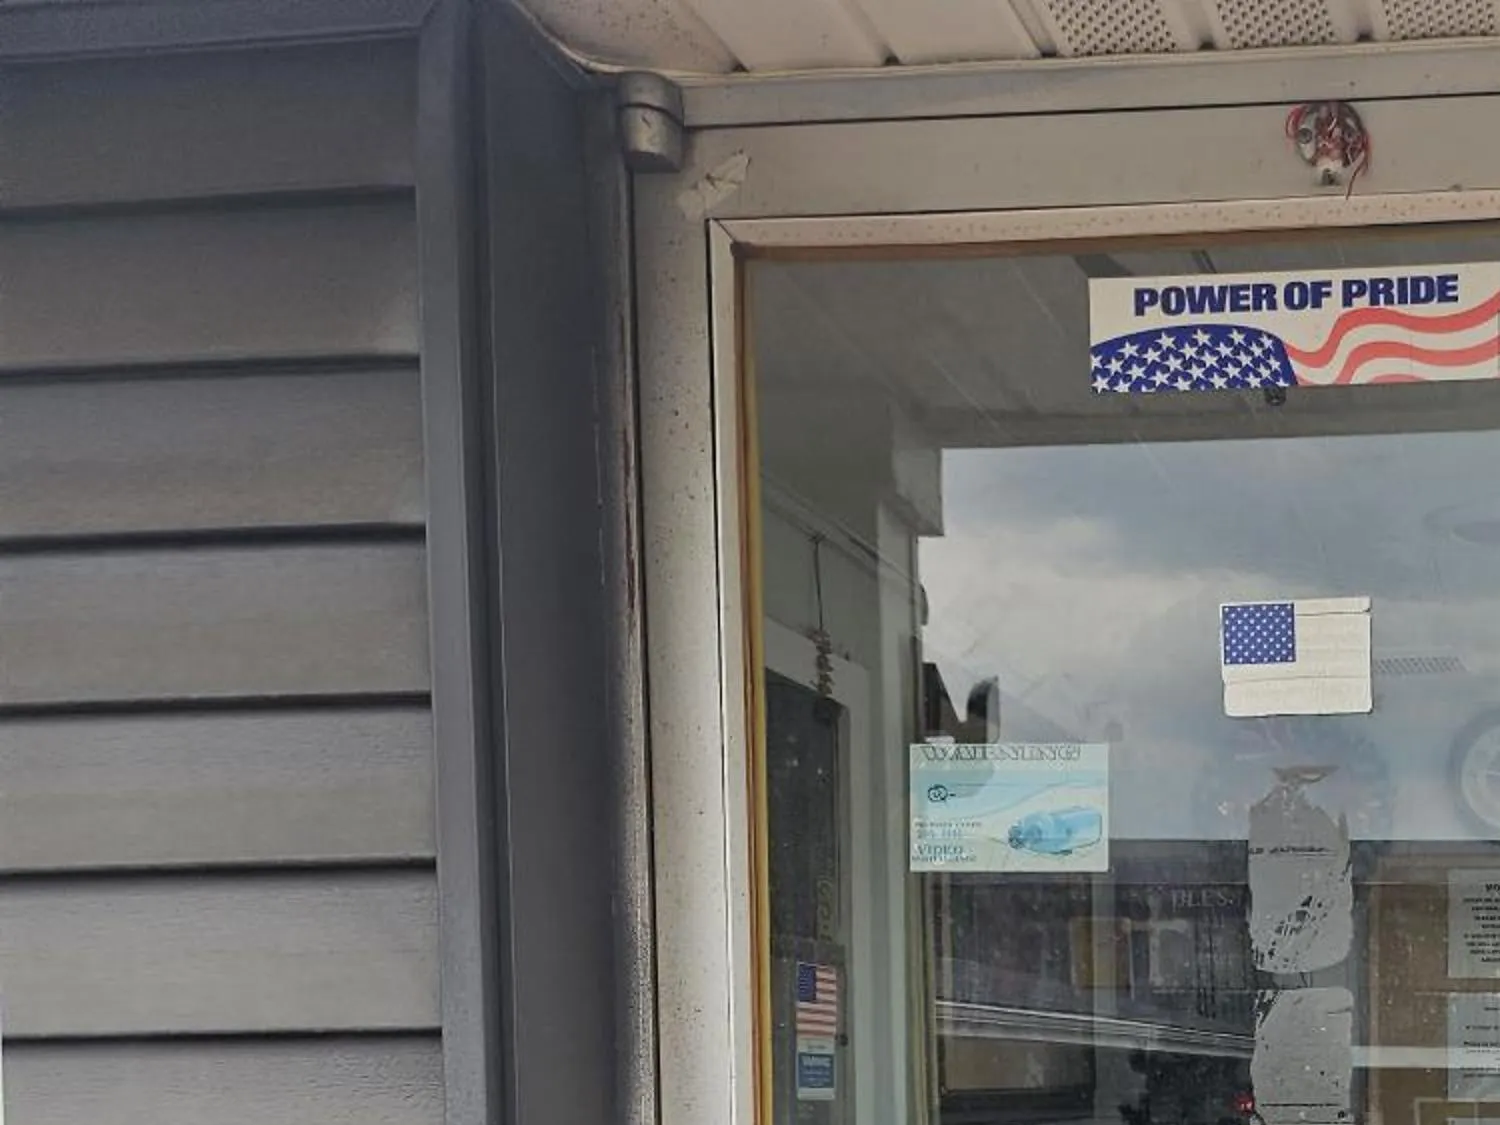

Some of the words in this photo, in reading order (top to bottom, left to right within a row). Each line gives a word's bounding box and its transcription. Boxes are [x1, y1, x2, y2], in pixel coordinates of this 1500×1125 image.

[1133, 283, 1277, 316] POWER
[1283, 279, 1332, 310] OF
[1341, 274, 1459, 308] PRIDE
[920, 744, 1082, 762] WARNING
